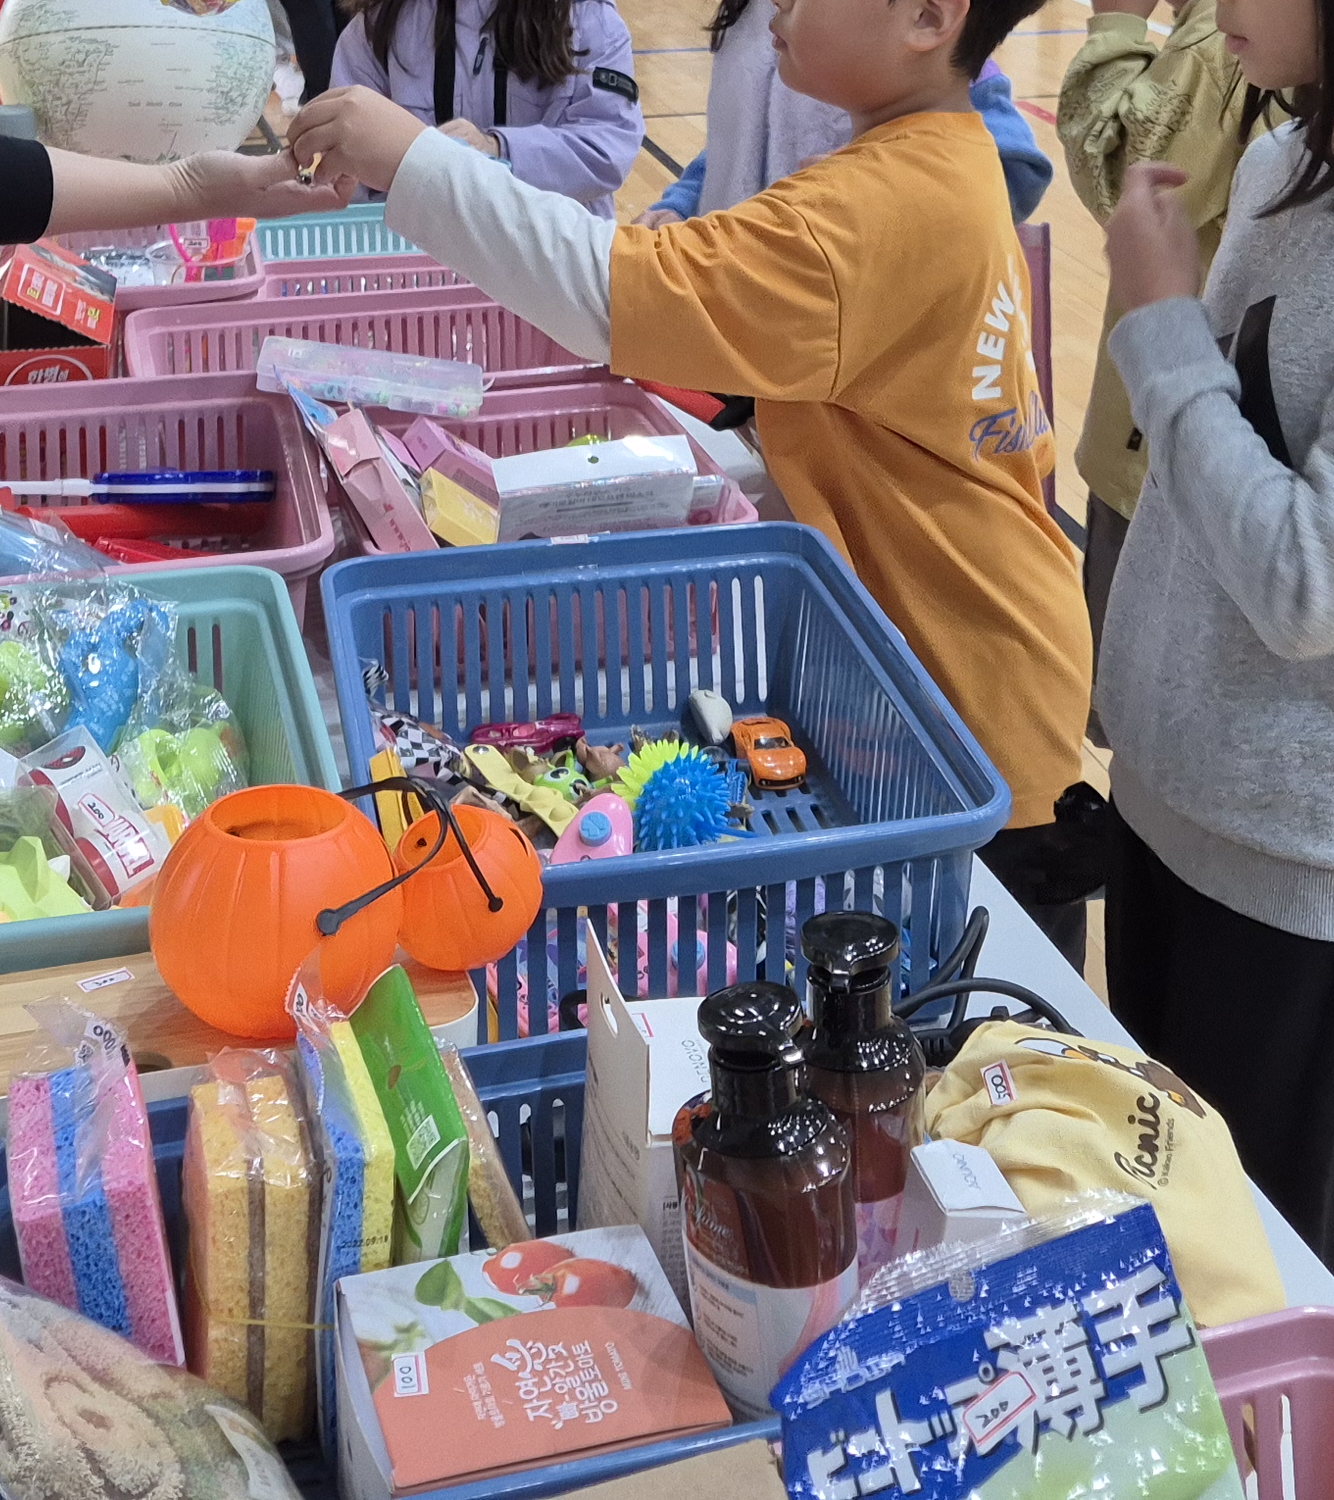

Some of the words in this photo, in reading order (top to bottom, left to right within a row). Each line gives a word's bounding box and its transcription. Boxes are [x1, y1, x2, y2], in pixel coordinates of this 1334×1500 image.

[971, 280, 1016, 401] NEW
[991, 1074, 1010, 1099] 500
[400, 1363, 413, 1390] 100
[571, 1339, 618, 1425] 방울토마토
[976, 1397, 1012, 1428] 200
